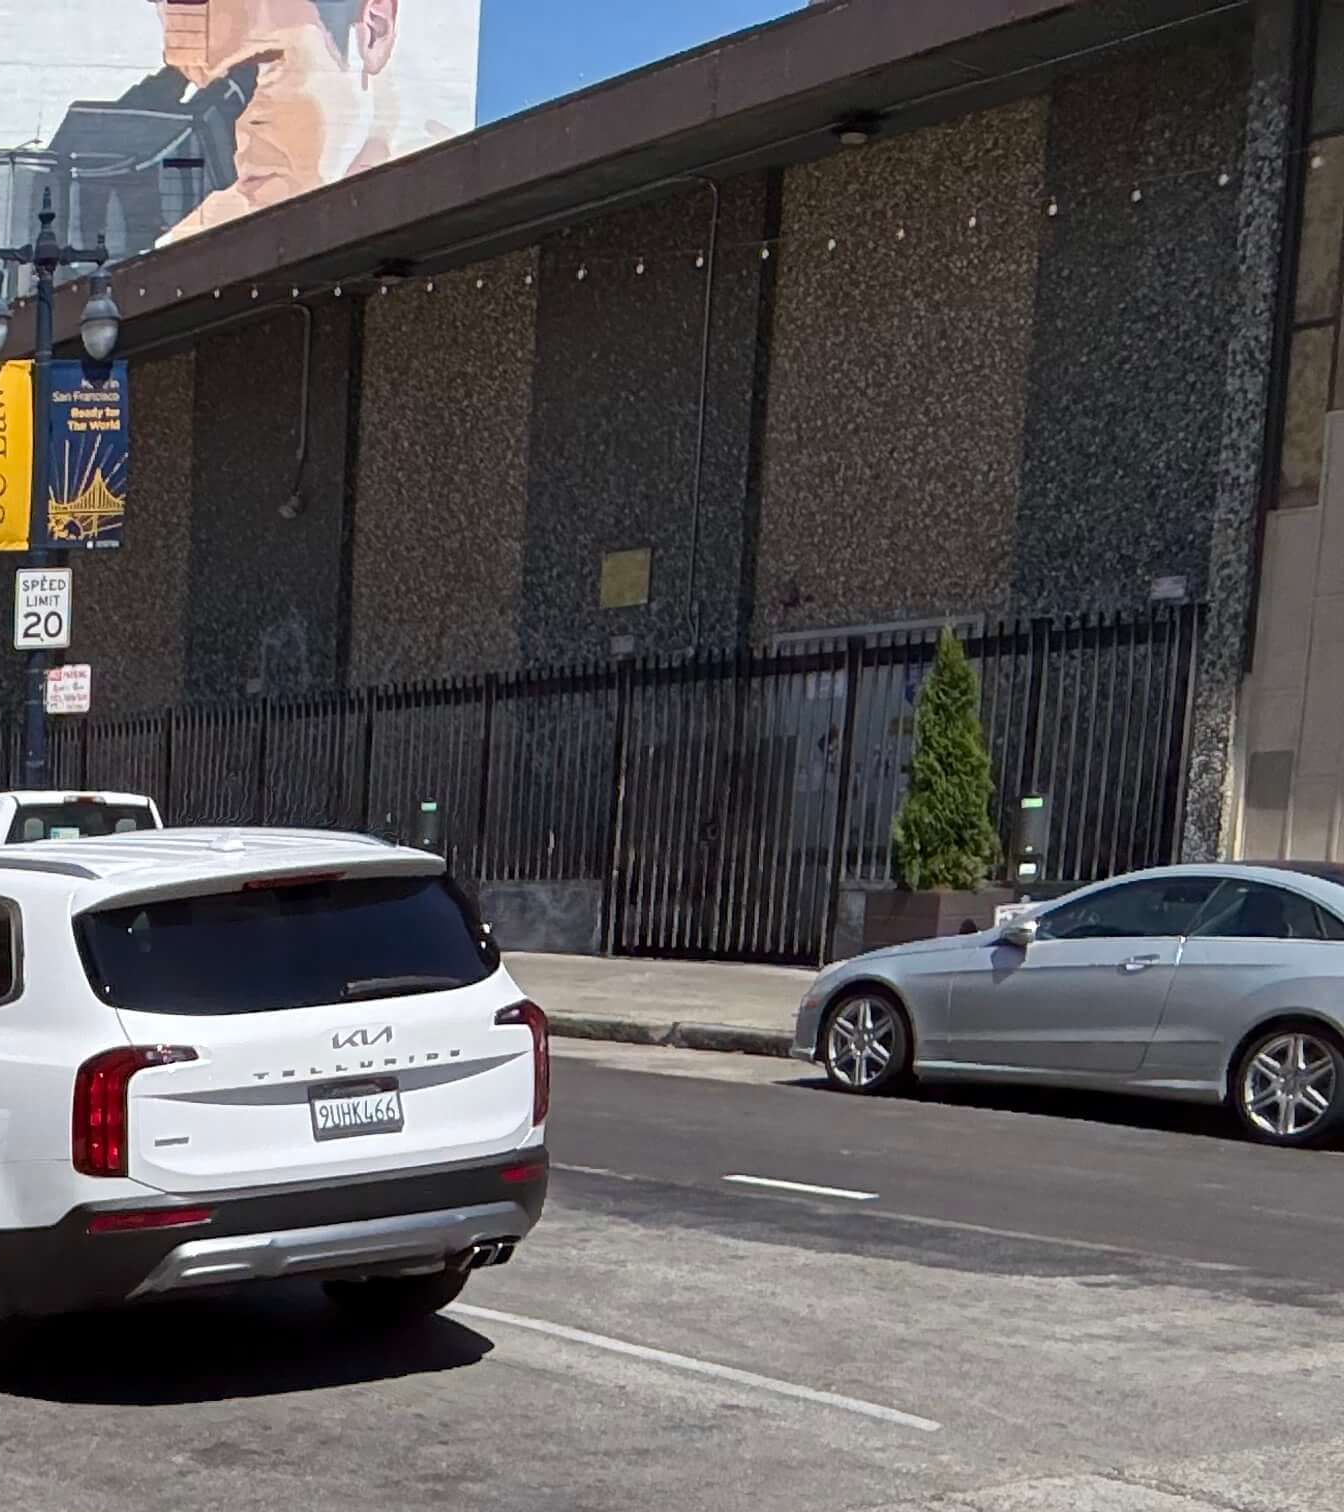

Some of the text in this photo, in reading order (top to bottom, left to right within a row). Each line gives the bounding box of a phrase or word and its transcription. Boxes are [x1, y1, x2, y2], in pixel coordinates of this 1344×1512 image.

[22, 580, 66, 592] SPEED
[26, 594, 61, 607] LIMIT
[23, 611, 63, 638] 20
[332, 1025, 393, 1049] KIA
[253, 1049, 461, 1080] TELLURIDE
[319, 1097, 396, 1128] 9UHK466
